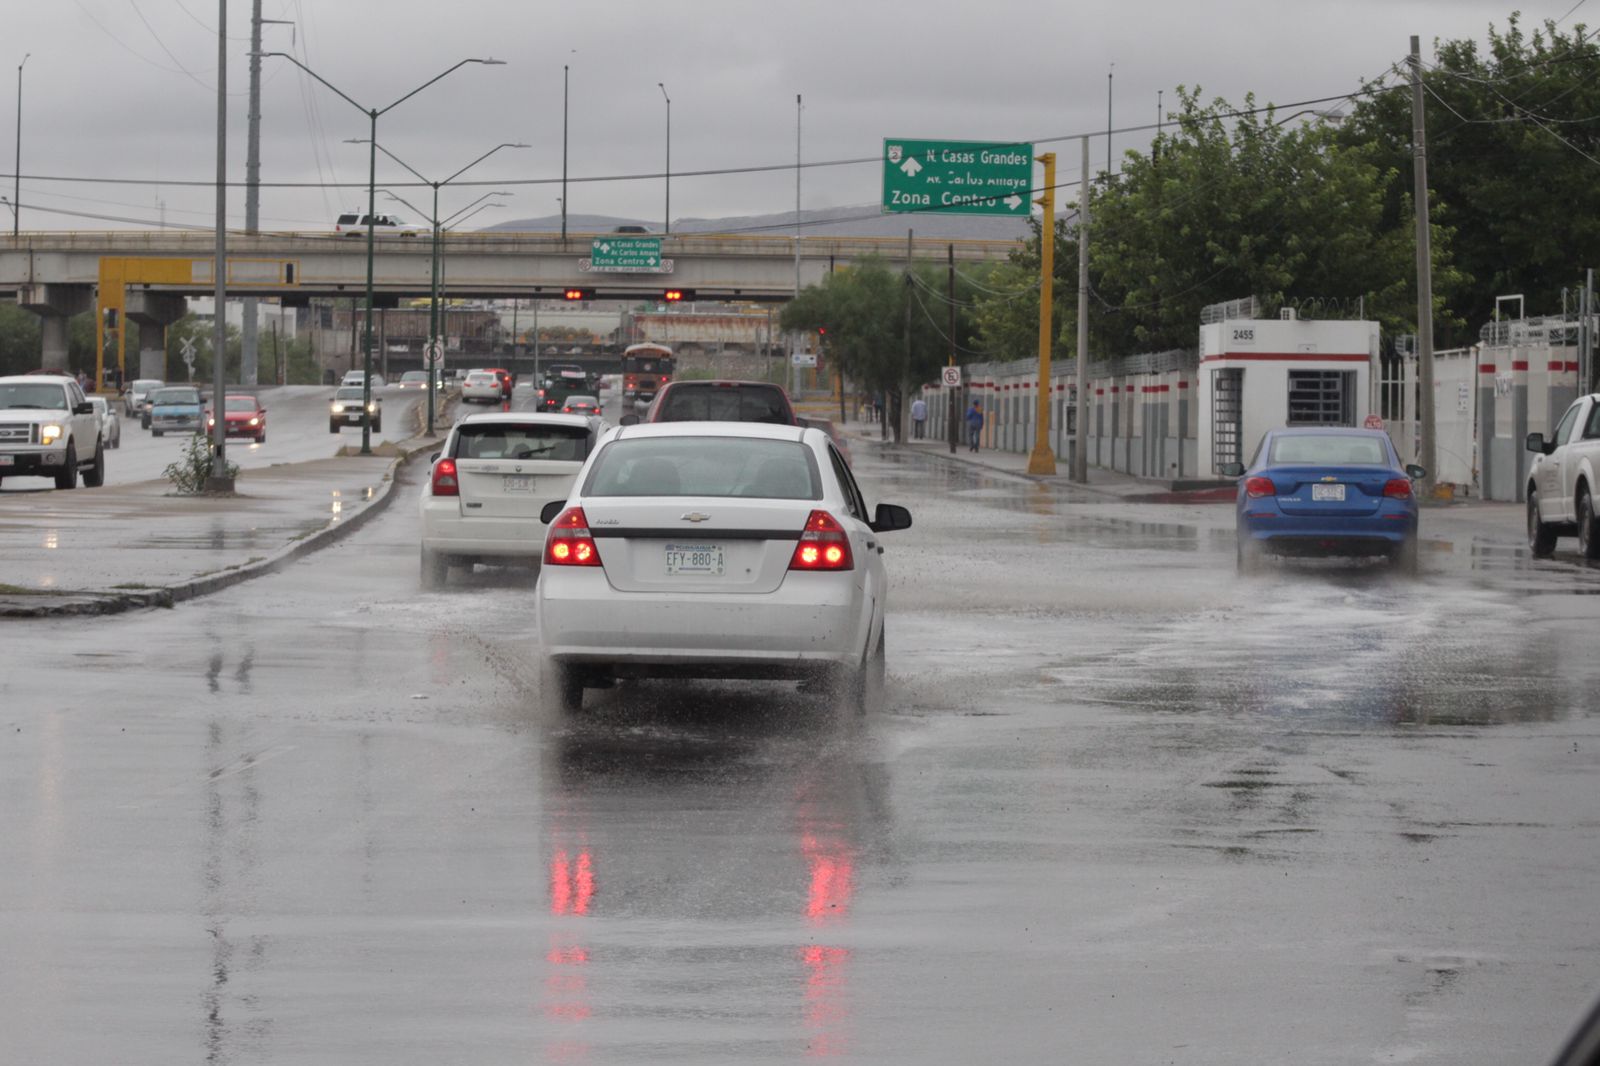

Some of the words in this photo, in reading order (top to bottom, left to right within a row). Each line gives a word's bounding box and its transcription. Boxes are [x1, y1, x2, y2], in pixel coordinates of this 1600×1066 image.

[892, 152, 898, 160] 2
[942, 149, 975, 164] Casas
[981, 151, 1027, 165] Grandes
[892, 190, 930, 205] Zona
[941, 192, 996, 207] Centro
[595, 257, 614, 265] Zona
[618, 257, 645, 265] Centro
[1233, 330, 1254, 340] 2455
[666, 552, 723, 566] EFY-880-A
